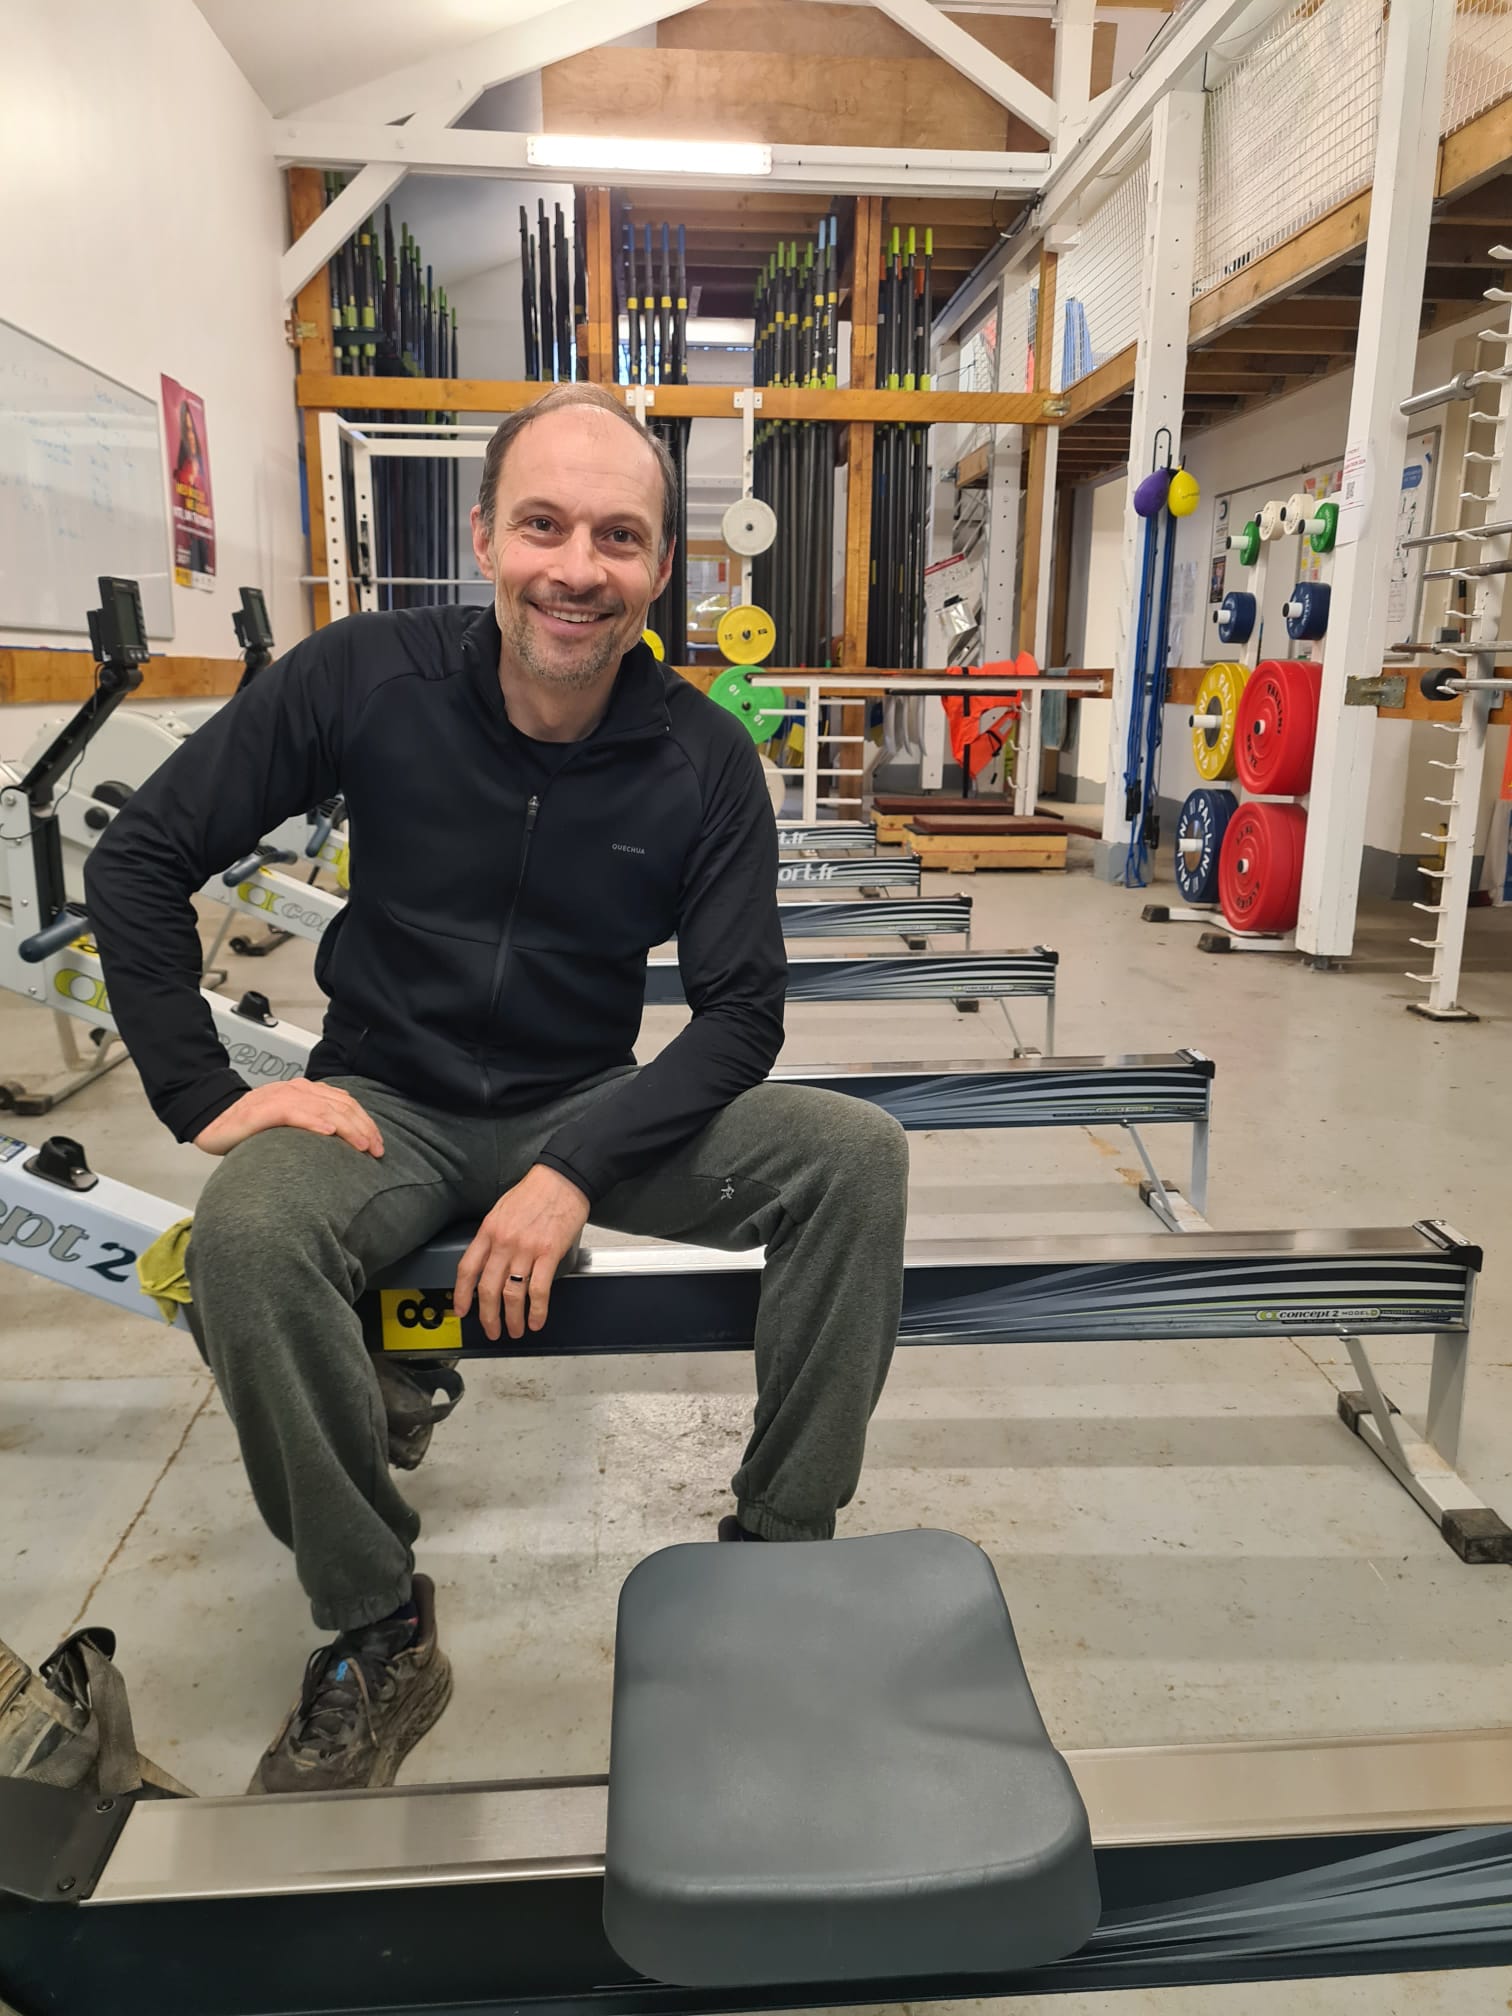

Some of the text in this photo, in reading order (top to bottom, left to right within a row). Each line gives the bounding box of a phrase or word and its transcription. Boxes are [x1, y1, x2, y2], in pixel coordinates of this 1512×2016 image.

[611, 843, 646, 855] QUECHUA
[1198, 798, 1213, 878] PALLINI
[86, 1241, 137, 1283] 2
[1279, 1309, 1331, 1319] concept
[1331, 1309, 1339, 1318] 2
